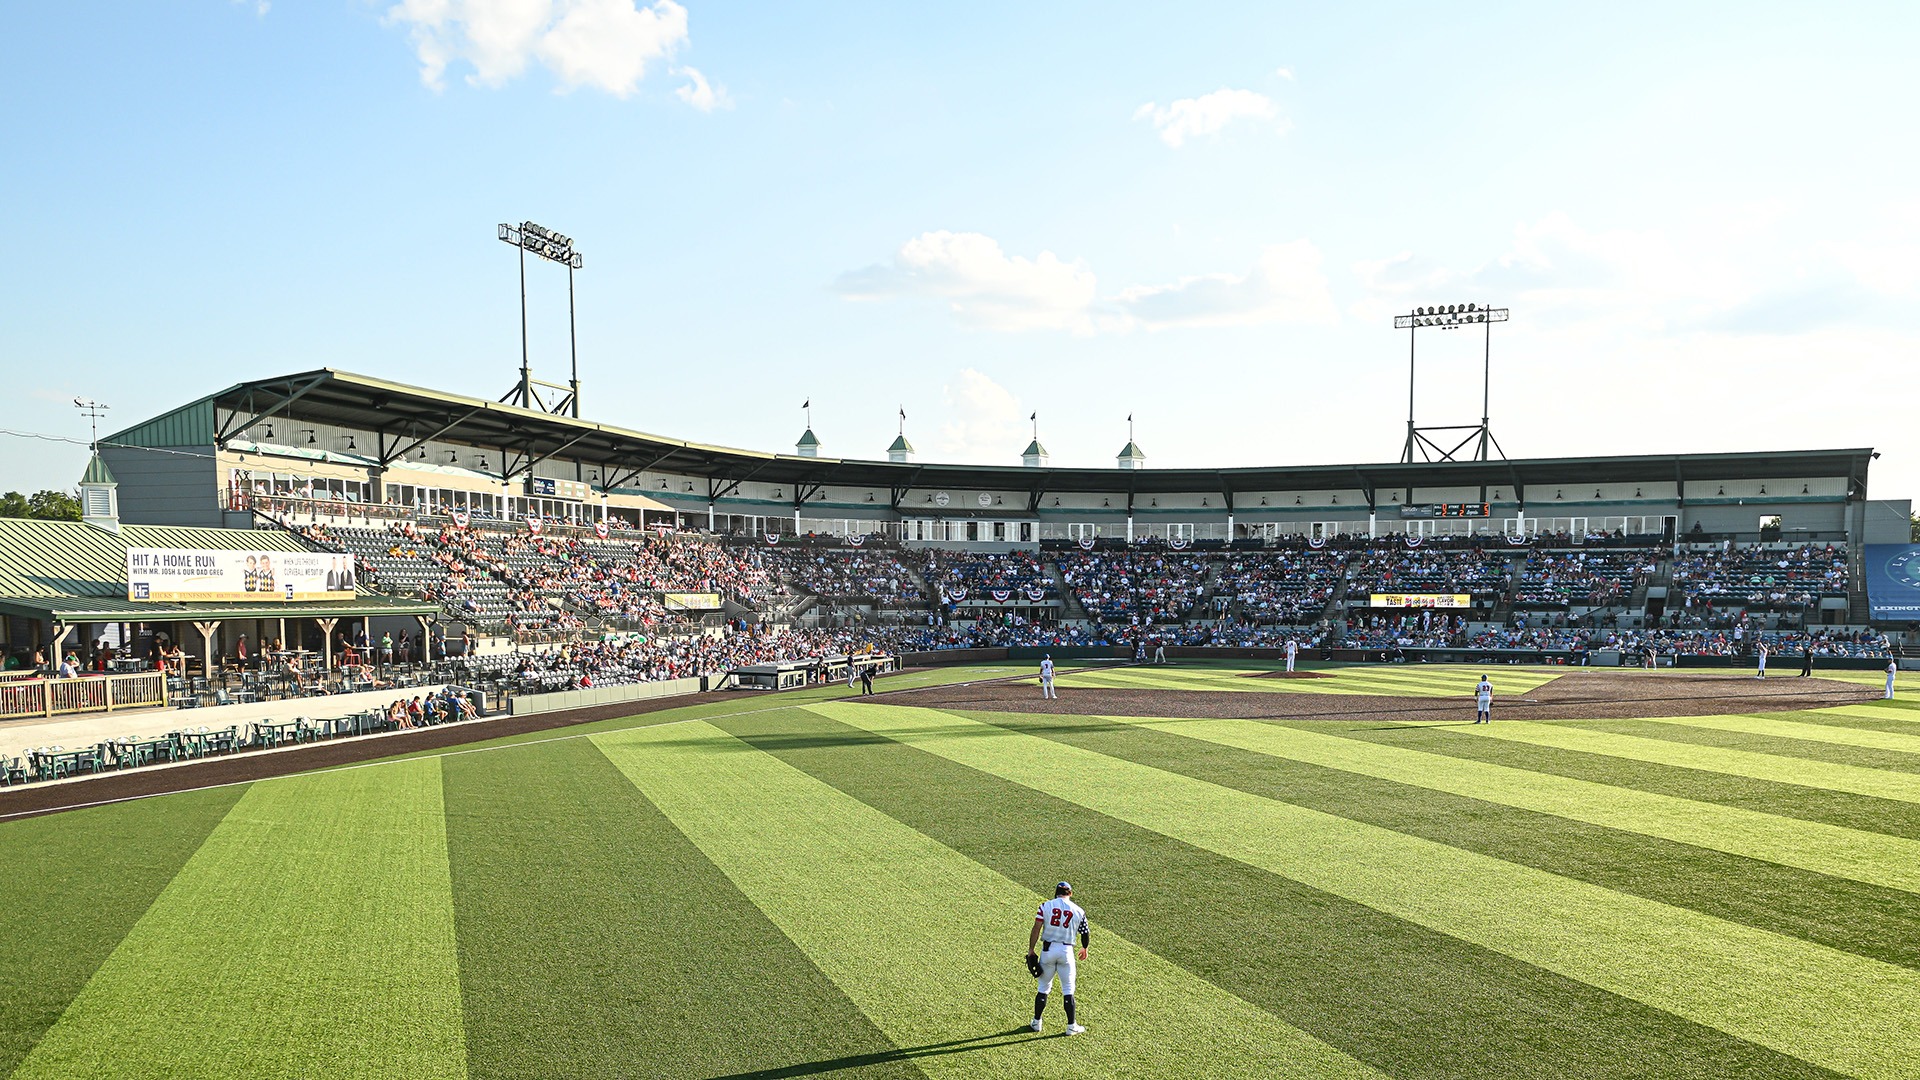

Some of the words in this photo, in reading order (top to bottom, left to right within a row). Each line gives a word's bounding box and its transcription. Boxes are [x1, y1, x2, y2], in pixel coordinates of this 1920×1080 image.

[132, 554, 149, 566] HIT
[153, 554, 160, 566] A
[163, 555, 192, 567] HOME
[195, 556, 216, 568] RUN
[161, 568, 176, 576] JOSH
[1050, 907, 1073, 928] 27
